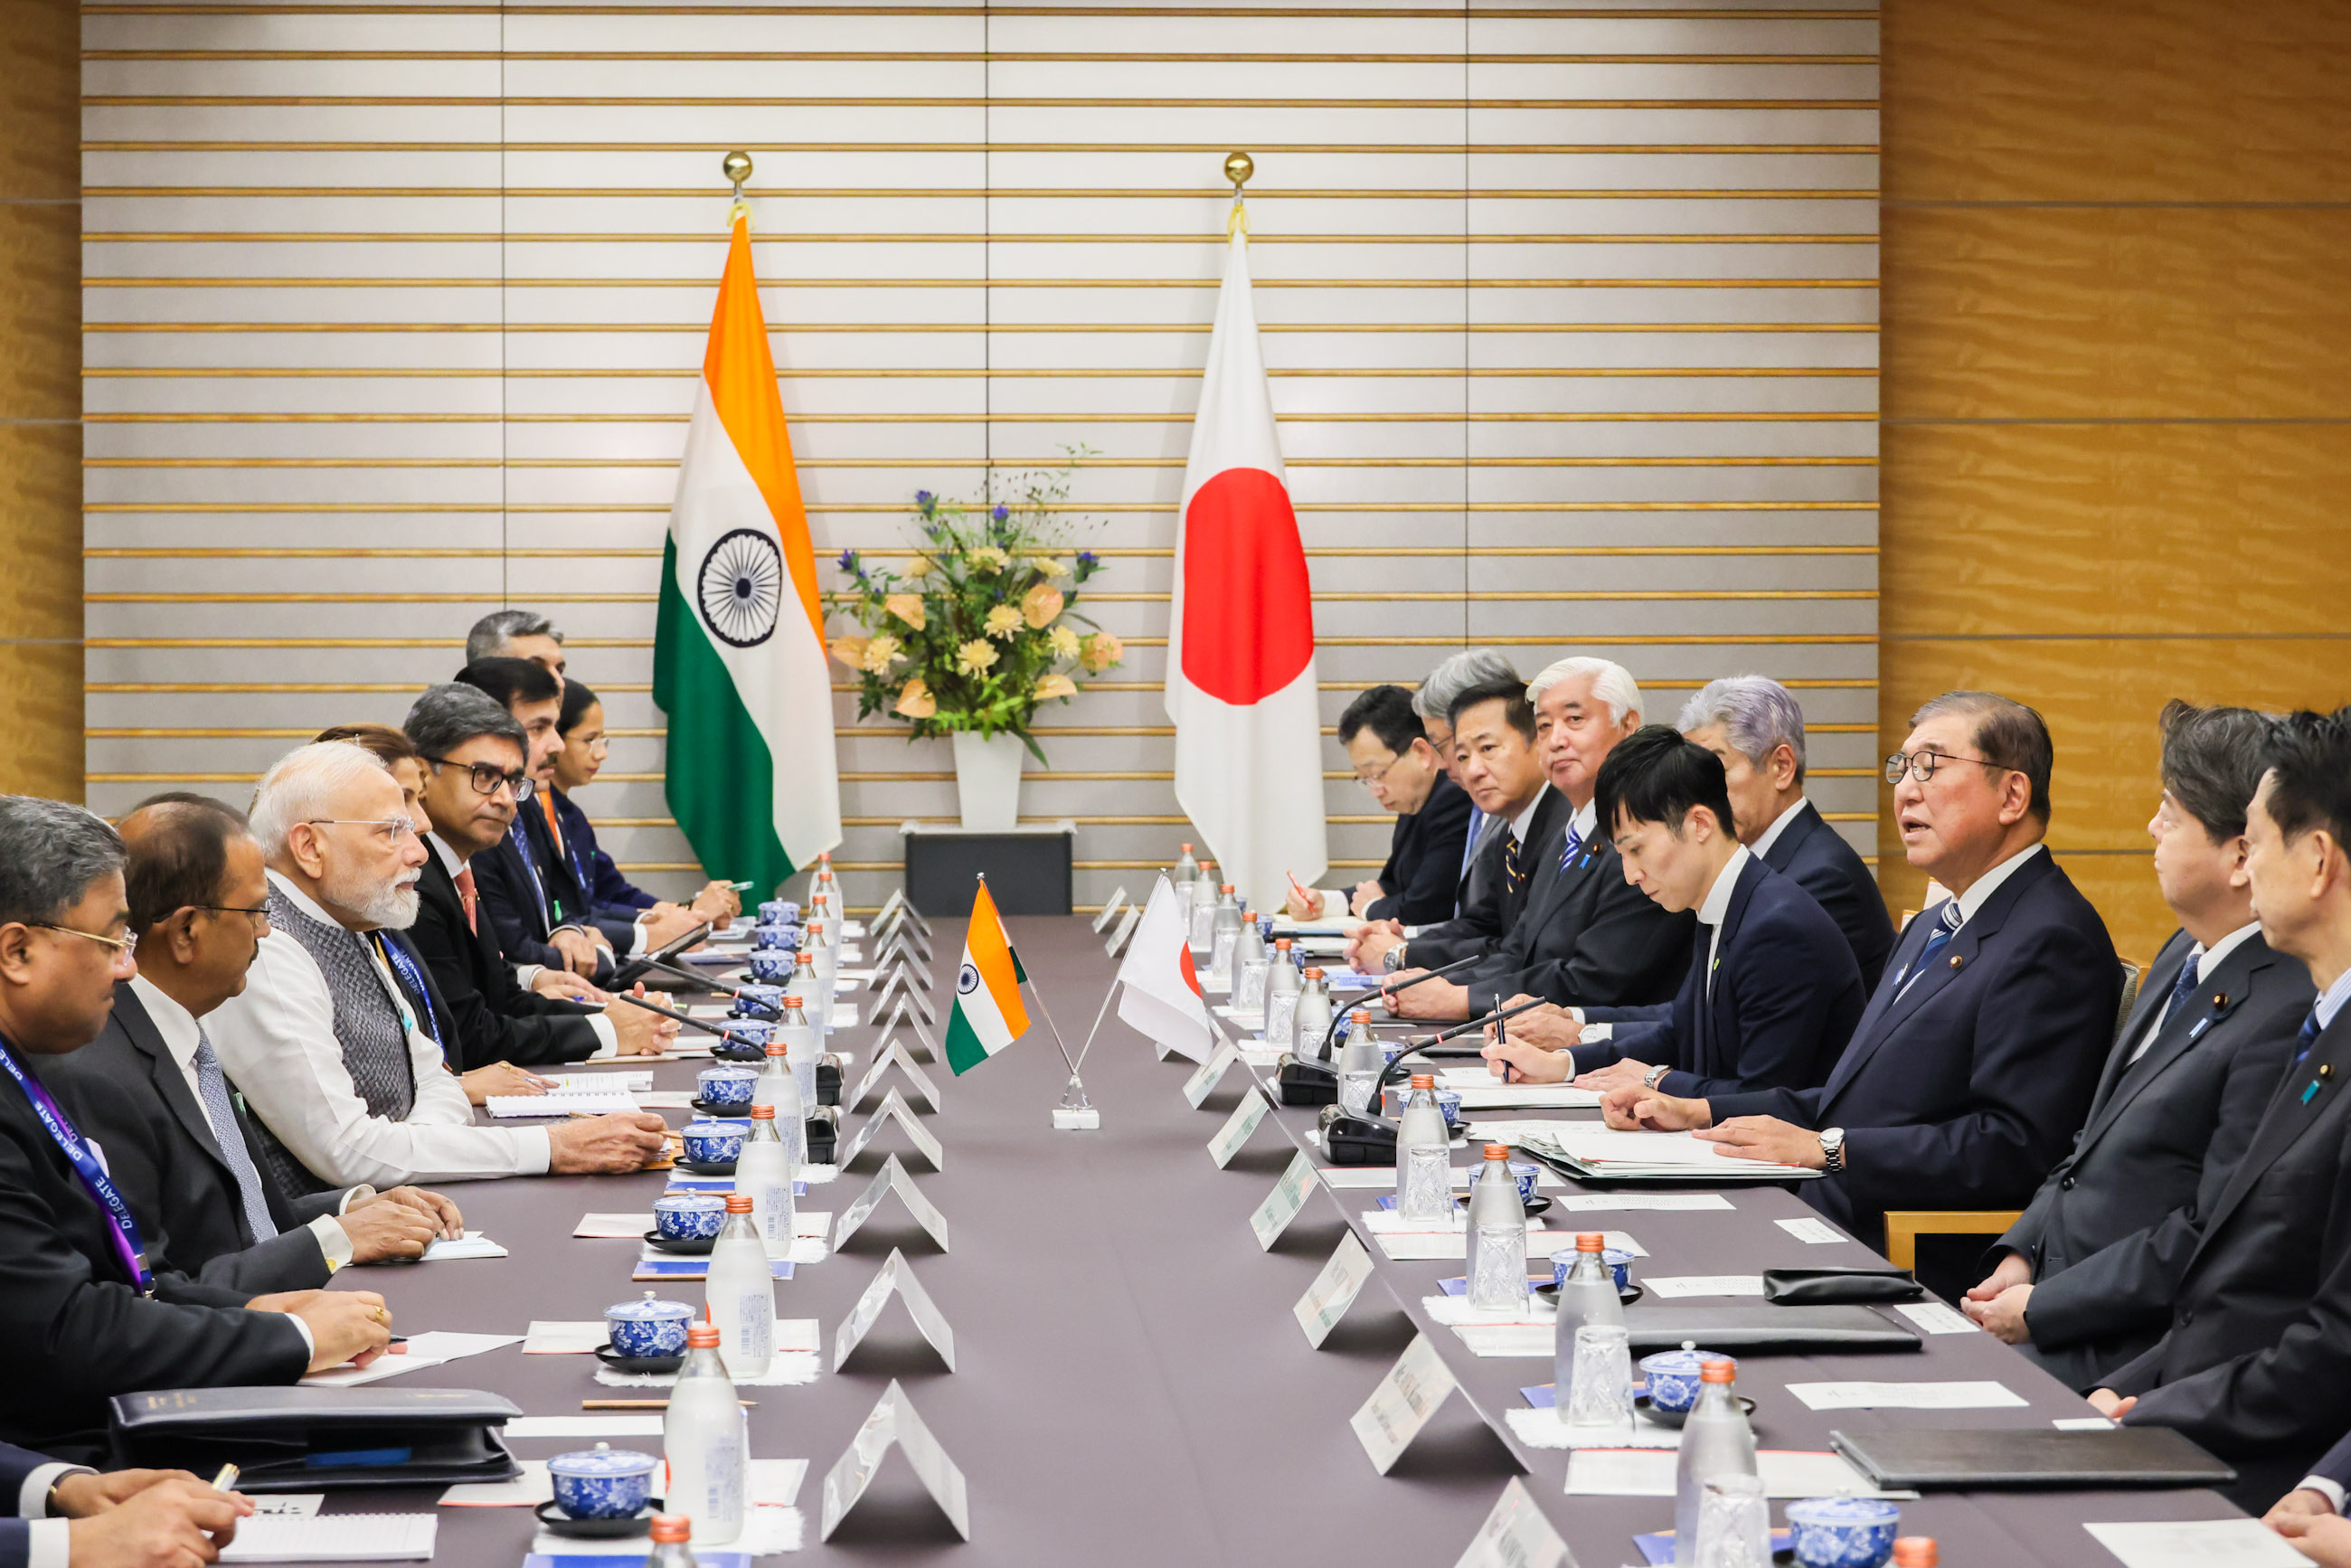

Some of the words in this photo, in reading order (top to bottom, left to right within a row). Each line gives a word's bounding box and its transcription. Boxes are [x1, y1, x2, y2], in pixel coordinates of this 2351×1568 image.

[391, 952, 420, 995] DELEGATE
[34, 1100, 84, 1162] DELEGATE
[94, 1176, 133, 1229] DELEGATE
